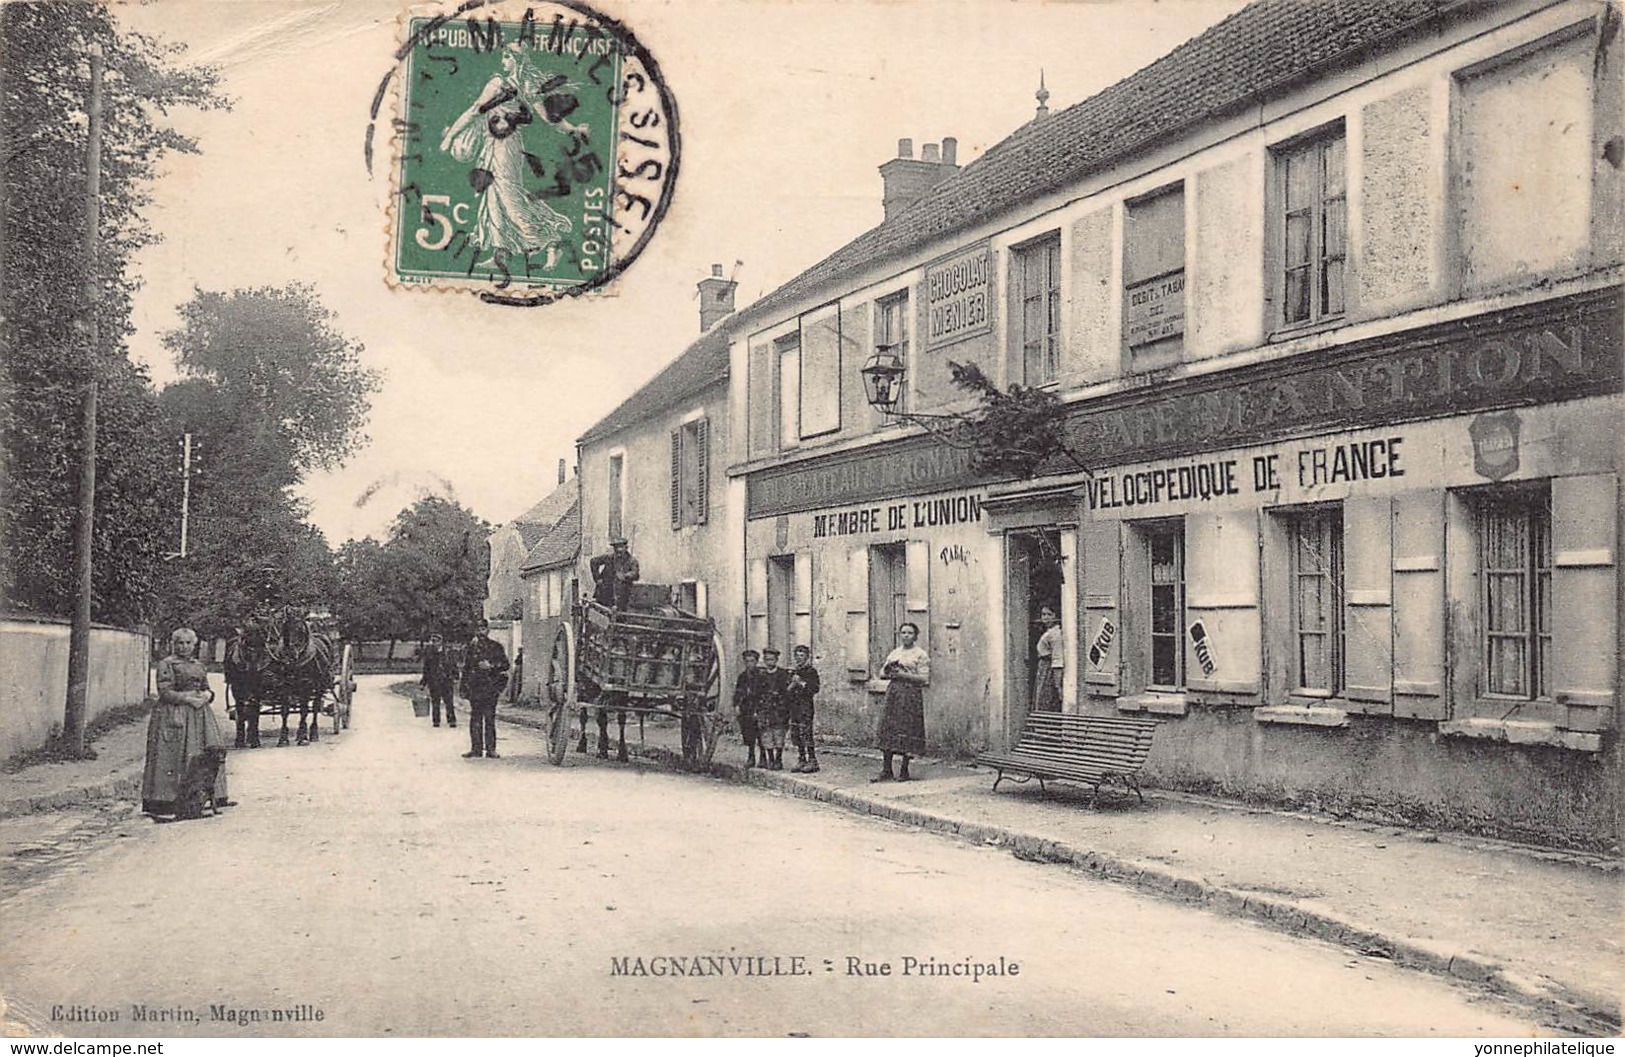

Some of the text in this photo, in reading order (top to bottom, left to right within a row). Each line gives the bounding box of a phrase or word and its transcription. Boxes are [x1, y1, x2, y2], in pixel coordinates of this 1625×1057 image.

[581, 186, 604, 271] POSTES
[929, 254, 987, 304] CHOCOLAT
[931, 291, 985, 337] MENIER
[1253, 455, 1281, 493] DE
[1298, 437, 1406, 487] FRANCE
[813, 494, 982, 539] MEMBRE DE L'UNION
[1096, 621, 1115, 654] KUB
[1194, 640, 1214, 675] KUB
